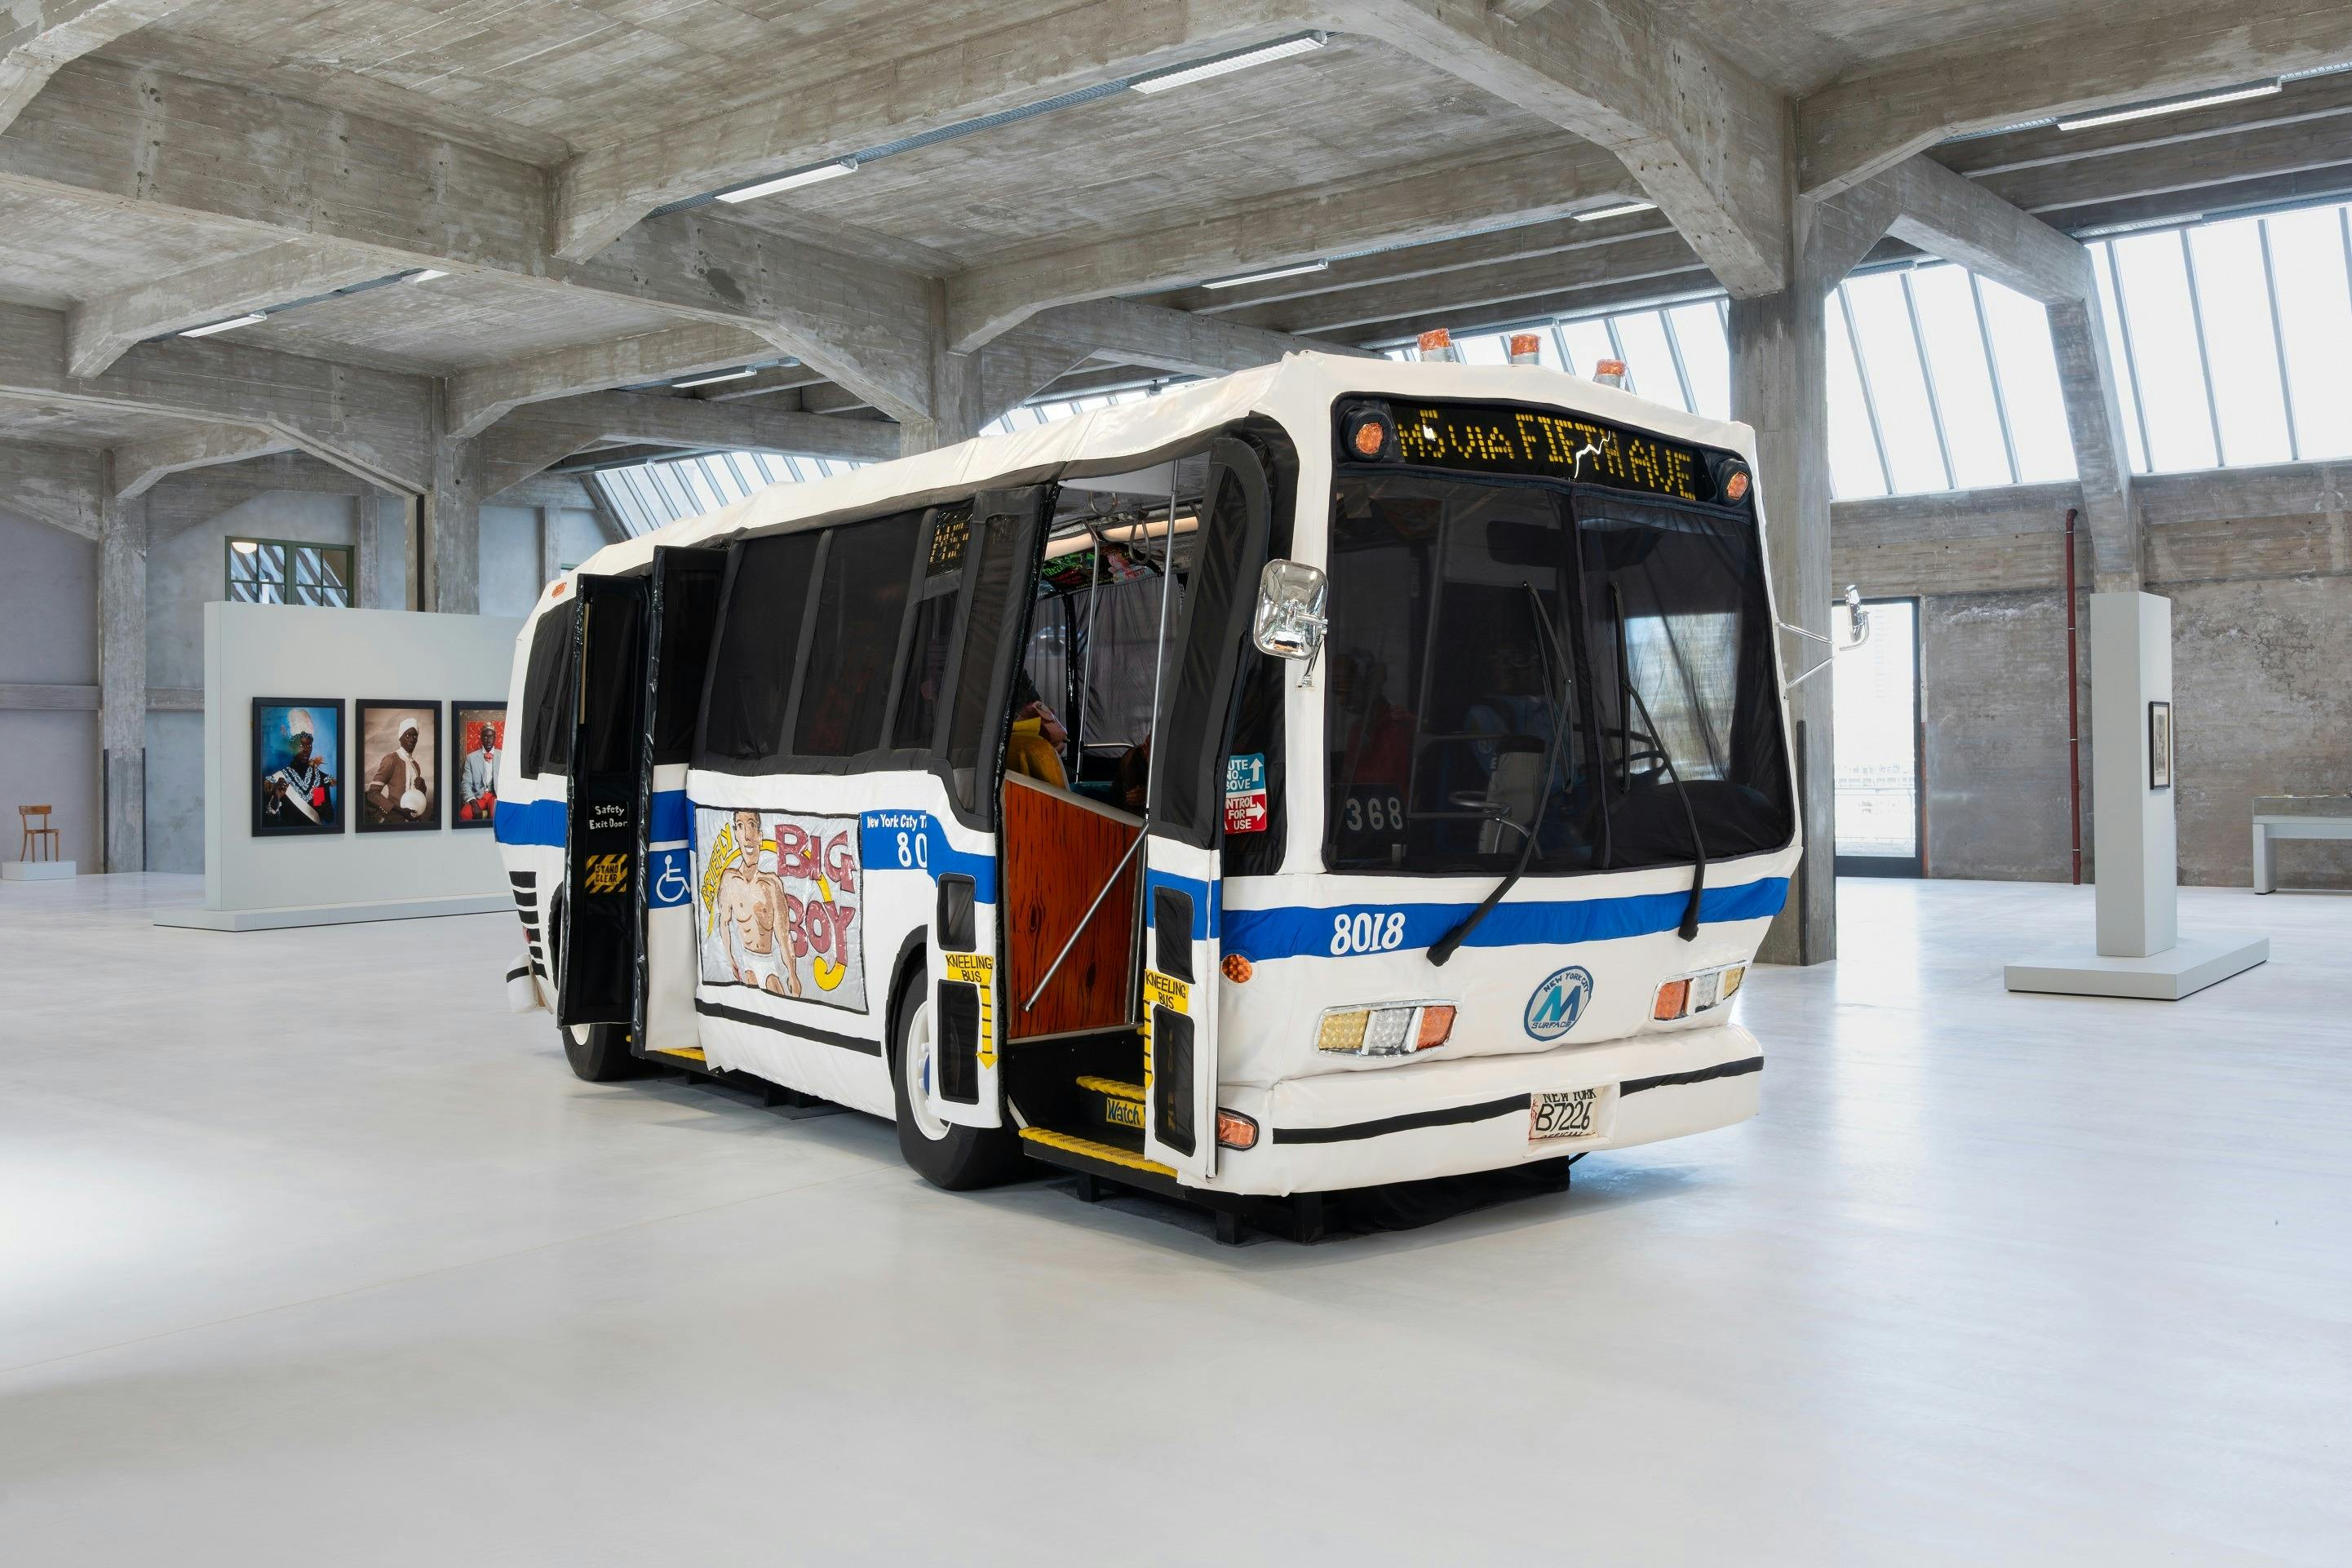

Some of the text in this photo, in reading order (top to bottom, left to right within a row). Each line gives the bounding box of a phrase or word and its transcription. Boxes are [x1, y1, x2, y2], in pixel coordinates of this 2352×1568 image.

[1448, 424, 1516, 460] VIA
[1515, 413, 1625, 478] FIFTH
[1628, 438, 1697, 502] AVE
[1228, 759, 1248, 771] UTE
[1226, 778, 1251, 791] BOVE
[1225, 795, 1256, 809] NTROL
[595, 804, 625, 817] Safety
[1228, 809, 1246, 820] FOR
[1346, 796, 1403, 831] 368
[589, 817, 628, 831] Exit Door
[866, 815, 879, 829] New
[879, 813, 899, 828] York
[900, 814, 919, 832] City
[1234, 818, 1251, 831] USE
[774, 823, 858, 894] BIG
[595, 865, 618, 875] STAND
[701, 822, 734, 913] BRIEFLY
[595, 874, 618, 884] CLEAR
[785, 893, 857, 967] BOY
[1330, 911, 1406, 955] 8018
[946, 955, 993, 970] KNEELING
[961, 969, 982, 983] BUS
[1543, 975, 1562, 993] NEW
[1145, 971, 1186, 999] KNEELING
[1158, 991, 1175, 1010] BUS
[1530, 1021, 1572, 1030] SURFACE
[1542, 1087, 1597, 1103] NEW YORK
[1107, 1099, 1141, 1125] Watch
[1535, 1101, 1593, 1132] B7226
